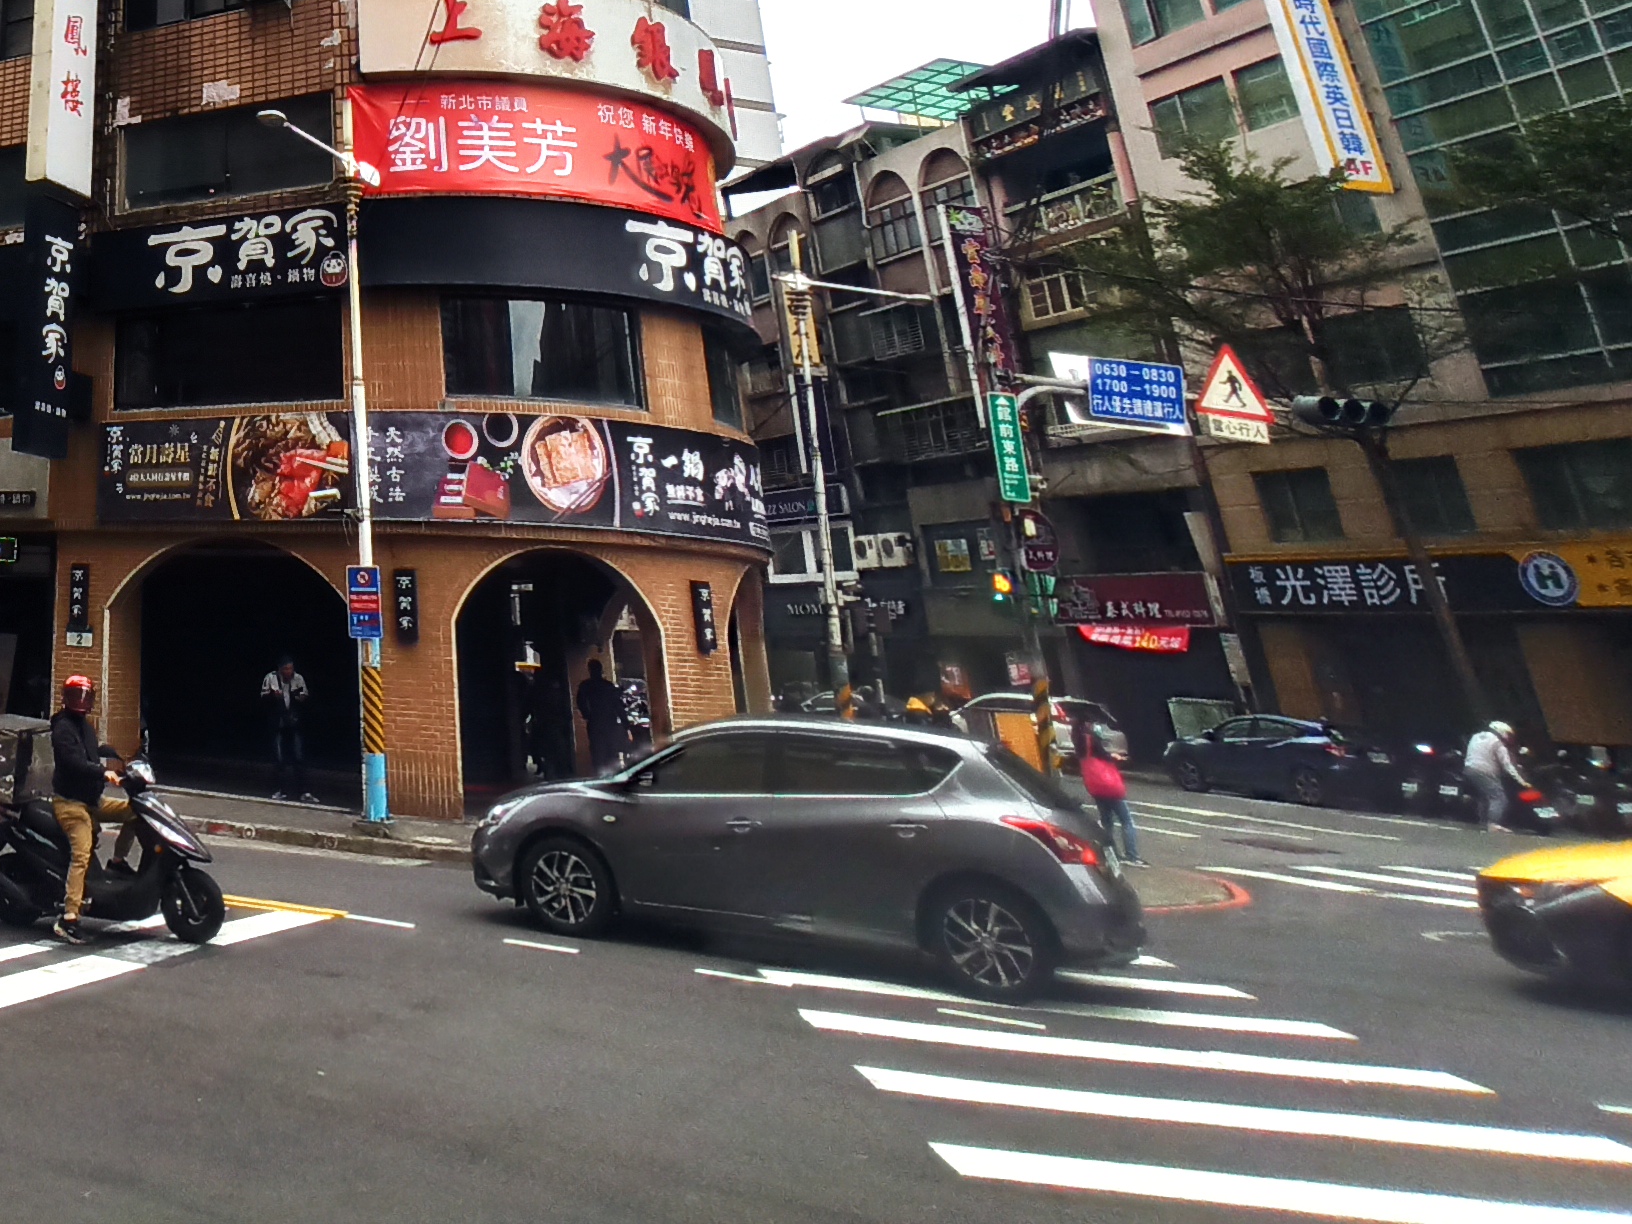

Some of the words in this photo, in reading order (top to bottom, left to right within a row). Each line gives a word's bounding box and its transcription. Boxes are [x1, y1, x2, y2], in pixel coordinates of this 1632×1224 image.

[440, 93, 529, 114] 新北市議員
[597, 102, 635, 129] 祝您
[389, 112, 579, 176] 劉美芳
[148, 208, 338, 294] 京賀家
[625, 219, 746, 299] 京賀家
[42, 234, 73, 364] 京賀家
[128, 442, 191, 464] 當月壽星
[386, 426, 406, 503] 天然古法
[996, 406, 1019, 472] 館前東路
[626, 435, 660, 516] 京賀家
[395, 575, 414, 631] 京賀家
[697, 587, 714, 642] 京賀家
[1105, 600, 1162, 619] 泰式料理
